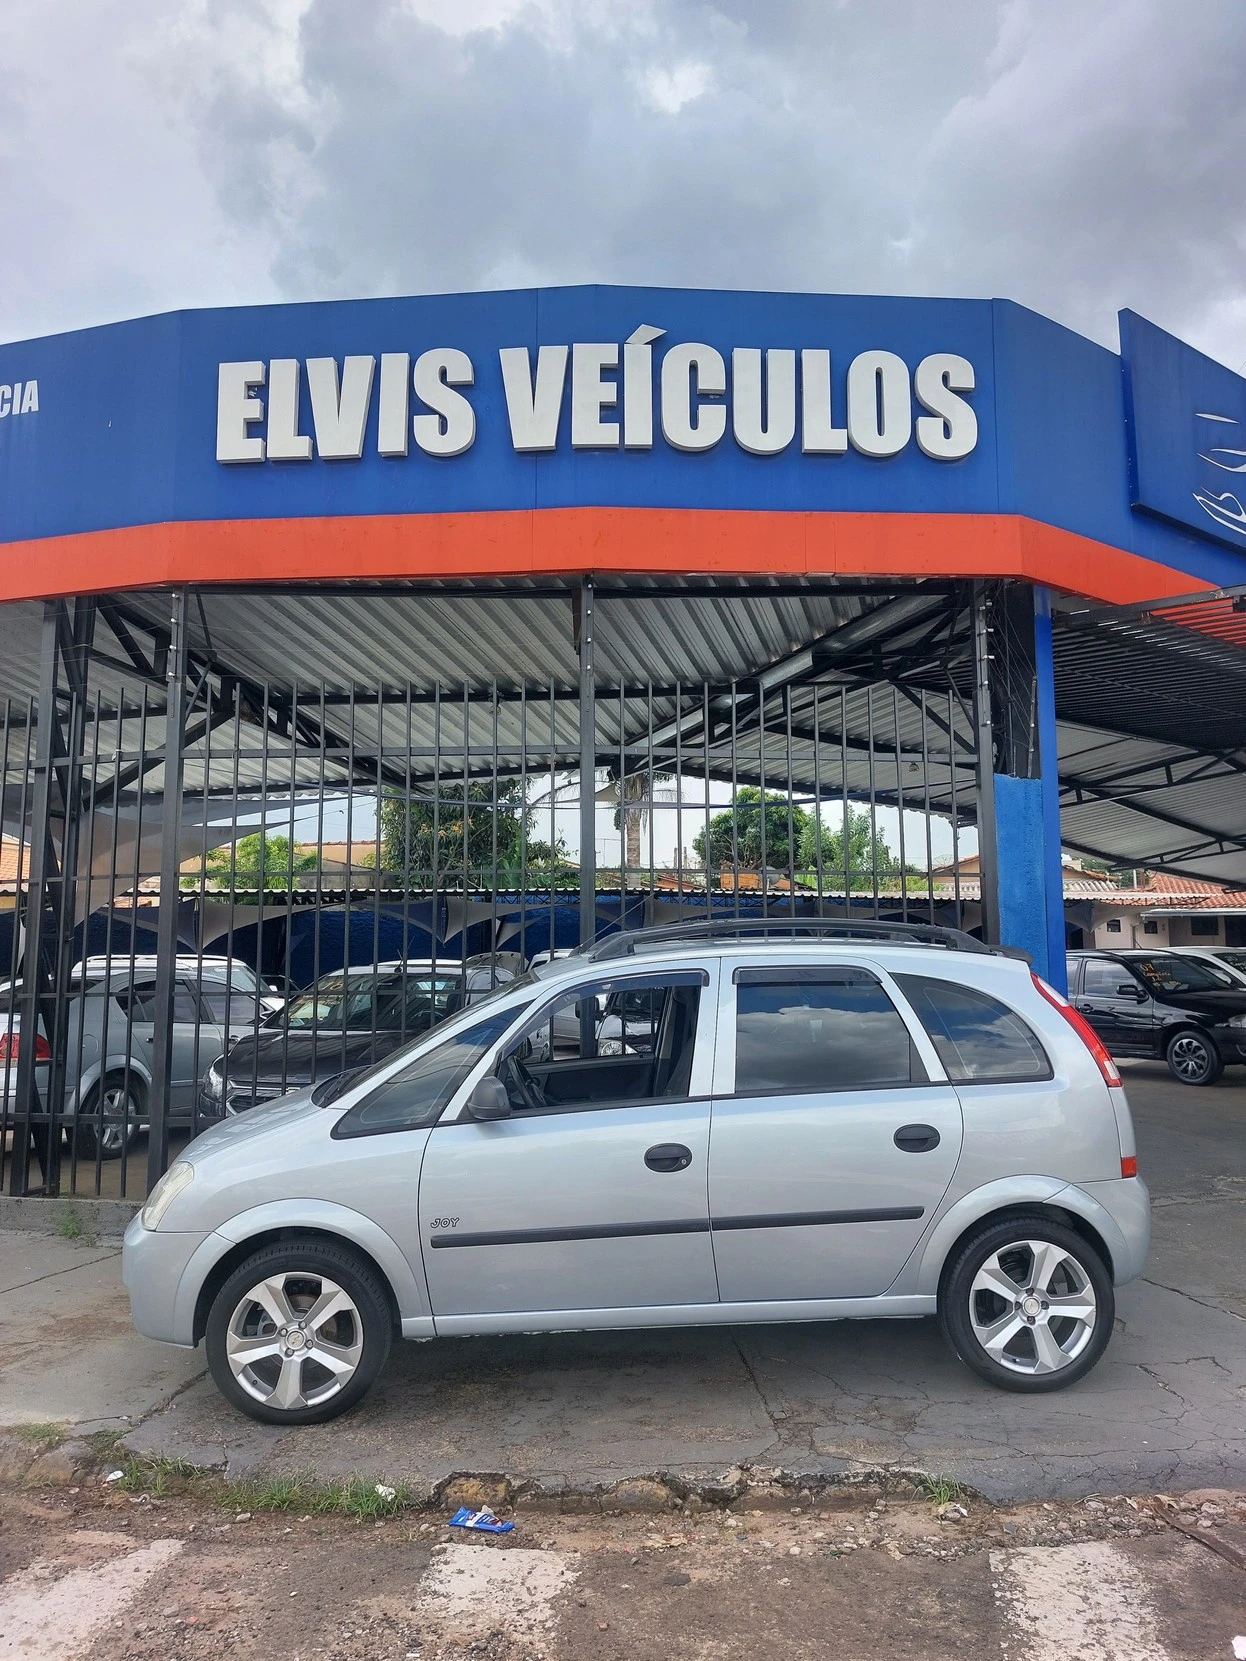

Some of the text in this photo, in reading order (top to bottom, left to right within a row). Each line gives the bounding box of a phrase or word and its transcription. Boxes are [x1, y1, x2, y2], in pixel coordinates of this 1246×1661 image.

[216, 323, 979, 465] ELVIS VEÍCULOS
[430, 1217, 460, 1229] JOY
